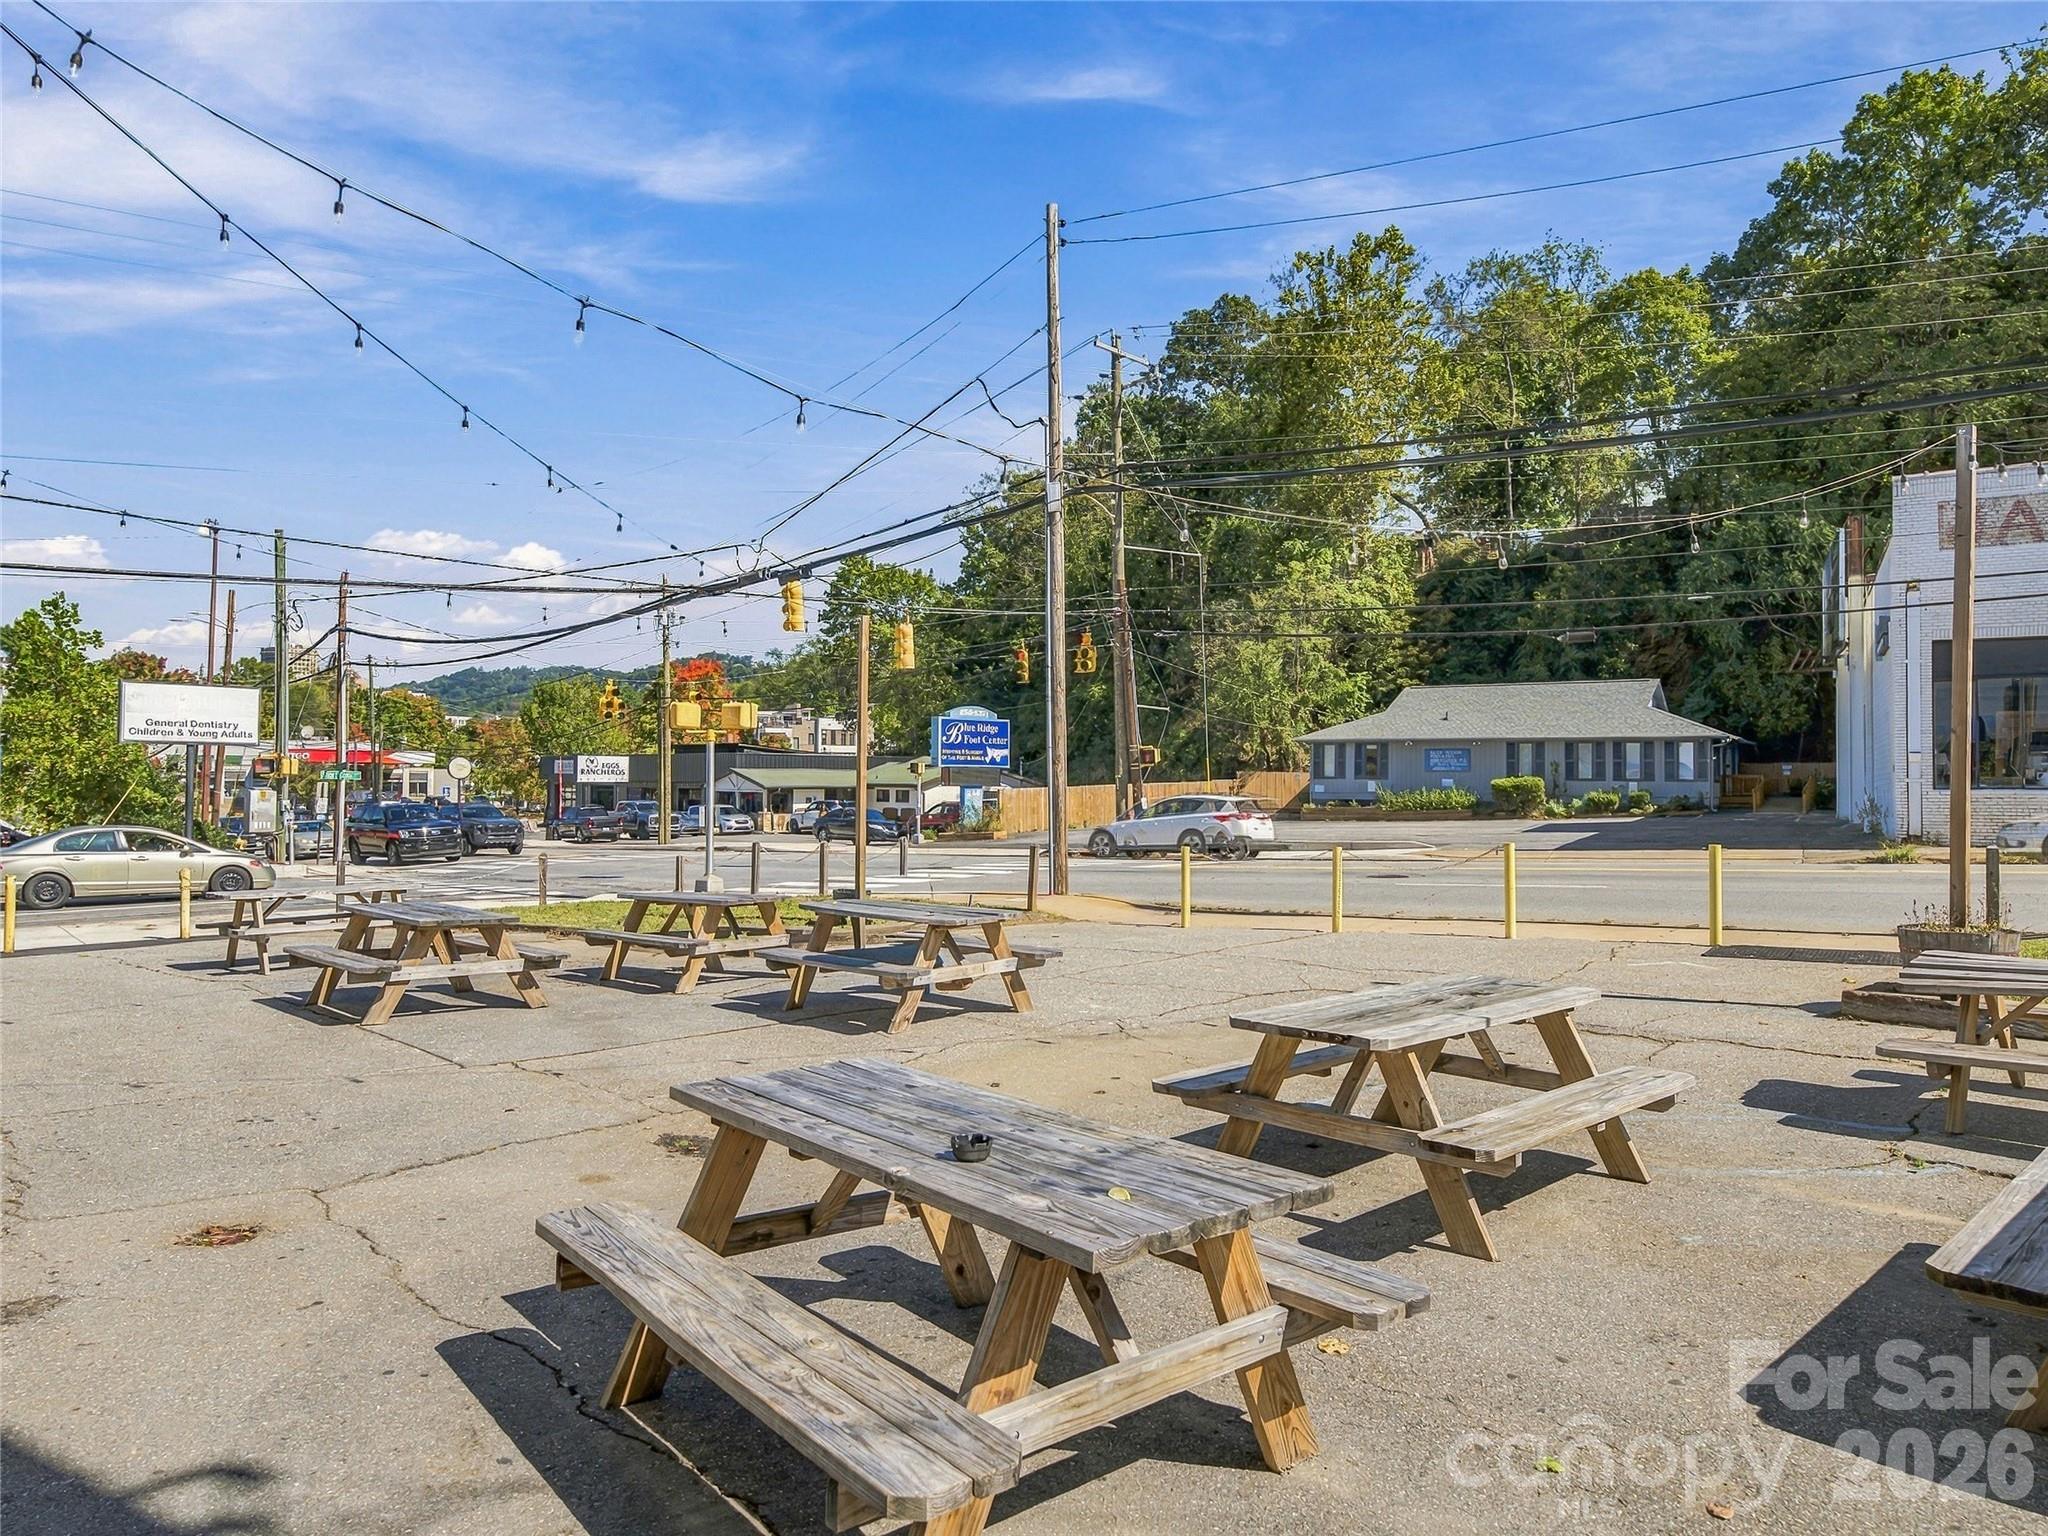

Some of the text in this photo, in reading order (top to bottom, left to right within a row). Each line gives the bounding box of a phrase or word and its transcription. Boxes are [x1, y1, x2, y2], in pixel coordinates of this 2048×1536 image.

[145, 718, 239, 730] General Dentistry
[977, 723, 999, 735] Ridge
[128, 727, 253, 739] Children & Young Adults
[963, 735, 1008, 745] Foot Center
